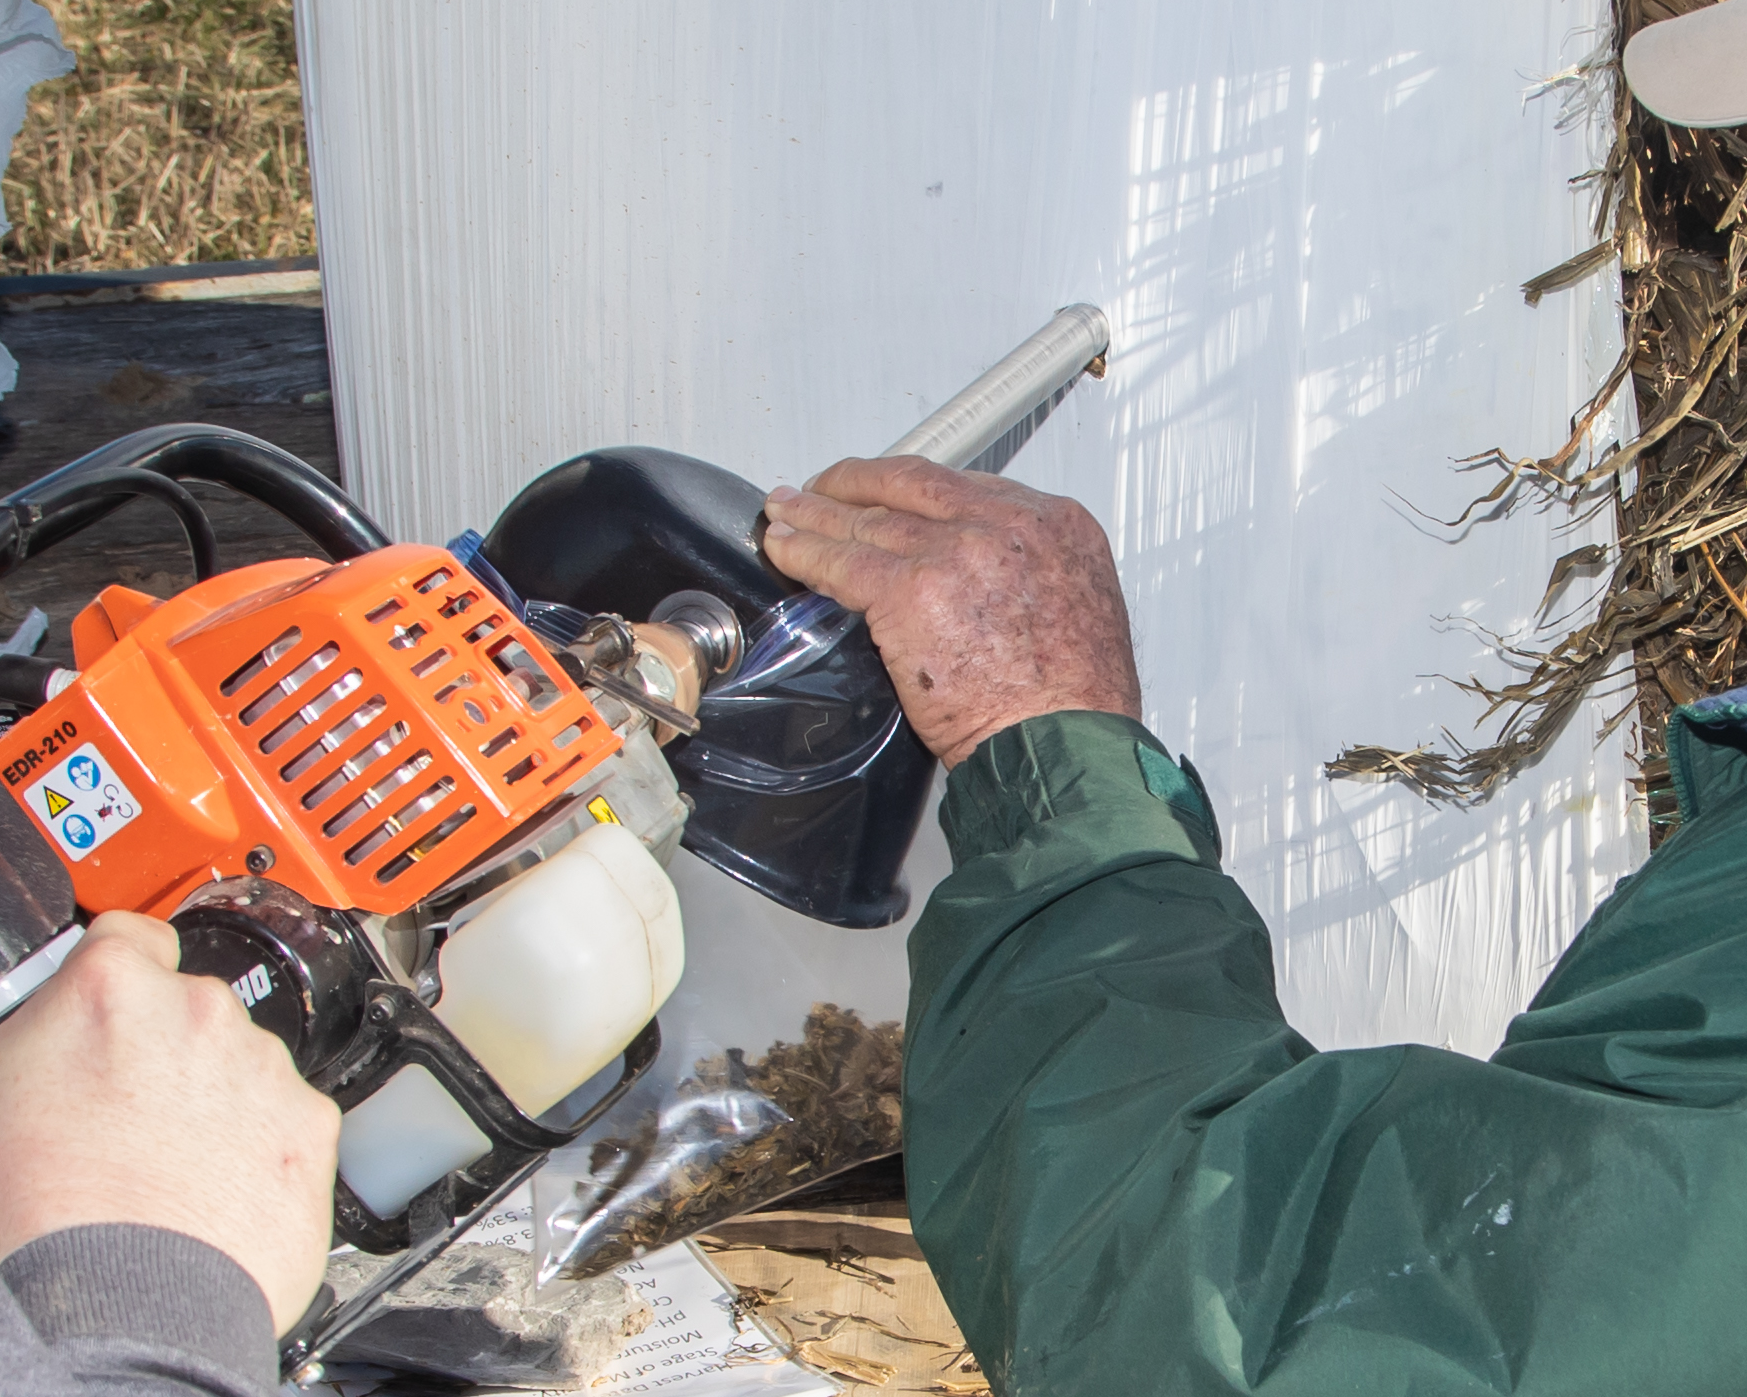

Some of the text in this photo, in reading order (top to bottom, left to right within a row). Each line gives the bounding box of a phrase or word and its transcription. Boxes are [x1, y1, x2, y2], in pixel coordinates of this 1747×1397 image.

[2, 720, 78, 787] EDR-210
[474, 1211, 518, 1231] 53%
[660, 1346, 718, 1368] Stage
[634, 1363, 656, 1378] of
[651, 1361, 733, 1388] Harvest
